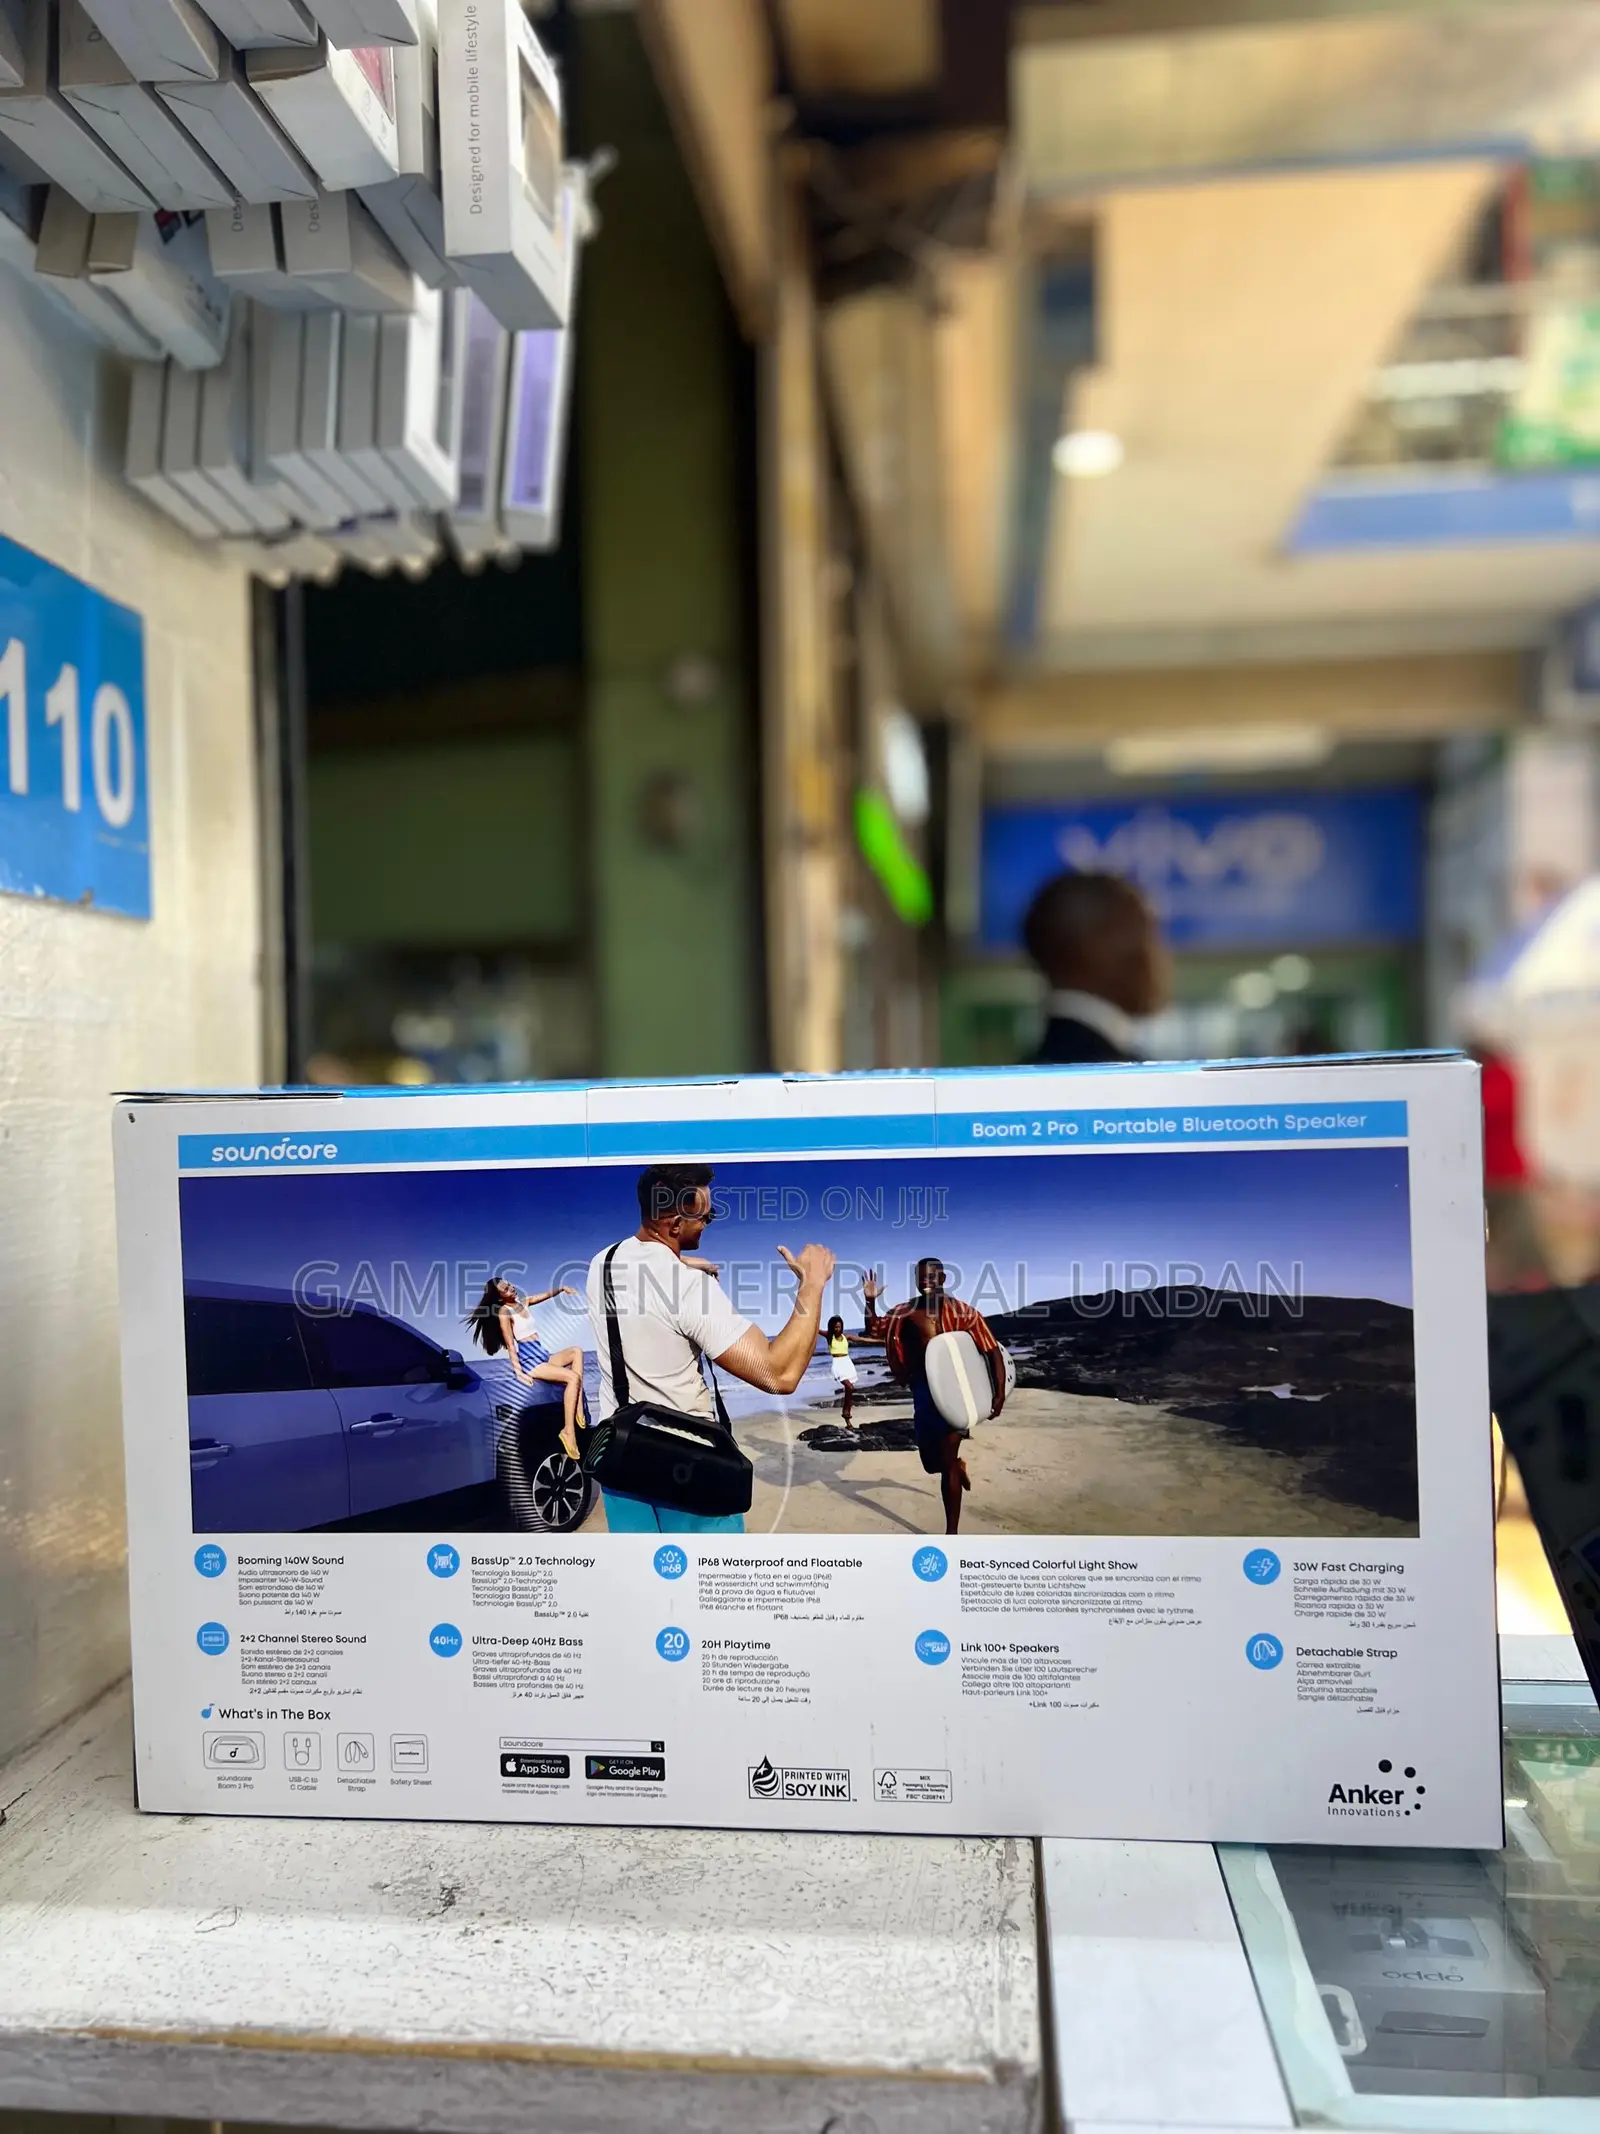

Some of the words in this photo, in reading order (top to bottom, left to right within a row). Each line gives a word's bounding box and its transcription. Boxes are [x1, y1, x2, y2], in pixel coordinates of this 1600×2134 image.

[464, 5, 479, 62] lifestyle
[467, 67, 480, 117] mobile
[468, 122, 481, 141] for
[468, 147, 484, 214] Designed
[972, 1122, 1027, 1137] Boom
[1032, 1122, 1041, 1136] 2
[1047, 1121, 1079, 1136] Pro
[1093, 1118, 1177, 1135] Portable
[1183, 1115, 1278, 1132] Bluetooth
[1284, 1113, 1367, 1131] Speaker
[211, 1136, 338, 1162] soundcore
[238, 1556, 282, 1566] Booming
[284, 1556, 310, 1565] 140W
[312, 1556, 344, 1565] Sound
[518, 1557, 533, 1566] 2.0
[535, 1557, 595, 1567] Technology
[698, 1558, 720, 1566] IP68
[722, 1558, 784, 1569] Waterproof
[786, 1558, 808, 1567] and
[811, 1558, 862, 1568] Floatable
[960, 1559, 1030, 1570] Beat-Synced
[1032, 1559, 1076, 1569] Colorful
[1078, 1560, 1105, 1571] Light
[1108, 1560, 1138, 1570] Show
[661, 1565, 681, 1573] IP68
[1293, 1562, 1319, 1572] 30W
[1321, 1563, 1346, 1572] Fast
[1348, 1563, 1404, 1574] Charging
[240, 1635, 256, 1643] 2+2
[258, 1635, 299, 1643] Channel
[301, 1635, 333, 1643] Stereo
[335, 1635, 367, 1643] Sound
[433, 1636, 458, 1645] 40Hz
[472, 1636, 529, 1646] Ultra-Deep
[531, 1637, 557, 1646] 40Hz
[559, 1638, 583, 1646] Bass
[664, 1633, 684, 1649] 20
[702, 1640, 721, 1649] 20H
[724, 1640, 771, 1651] Playtime
[961, 1643, 982, 1652] Link
[984, 1644, 1007, 1652] 100+
[1009, 1644, 1059, 1654] Speakers
[1296, 1647, 1364, 1657] Detachable
[1366, 1648, 1398, 1659] Strap
[743, 1662, 789, 1670] Wiedergabe
[1048, 1666, 1098, 1675] Lautsprecher
[219, 1709, 263, 1719] What's
[266, 1709, 277, 1719] in
[281, 1709, 304, 1720] The
[308, 1709, 331, 1720] Box
[503, 1740, 543, 1748] soundcore
[520, 1765, 539, 1774] App
[540, 1765, 565, 1774] Store
[609, 1766, 641, 1777] Google
[642, 1767, 660, 1778] Play
[785, 1772, 822, 1780] PRINTED
[825, 1772, 847, 1781] WITH
[785, 1784, 816, 1796] SOY
[820, 1785, 847, 1797] INK
[1328, 1783, 1404, 1805] Anker
[1328, 1806, 1400, 1817] Innovations
